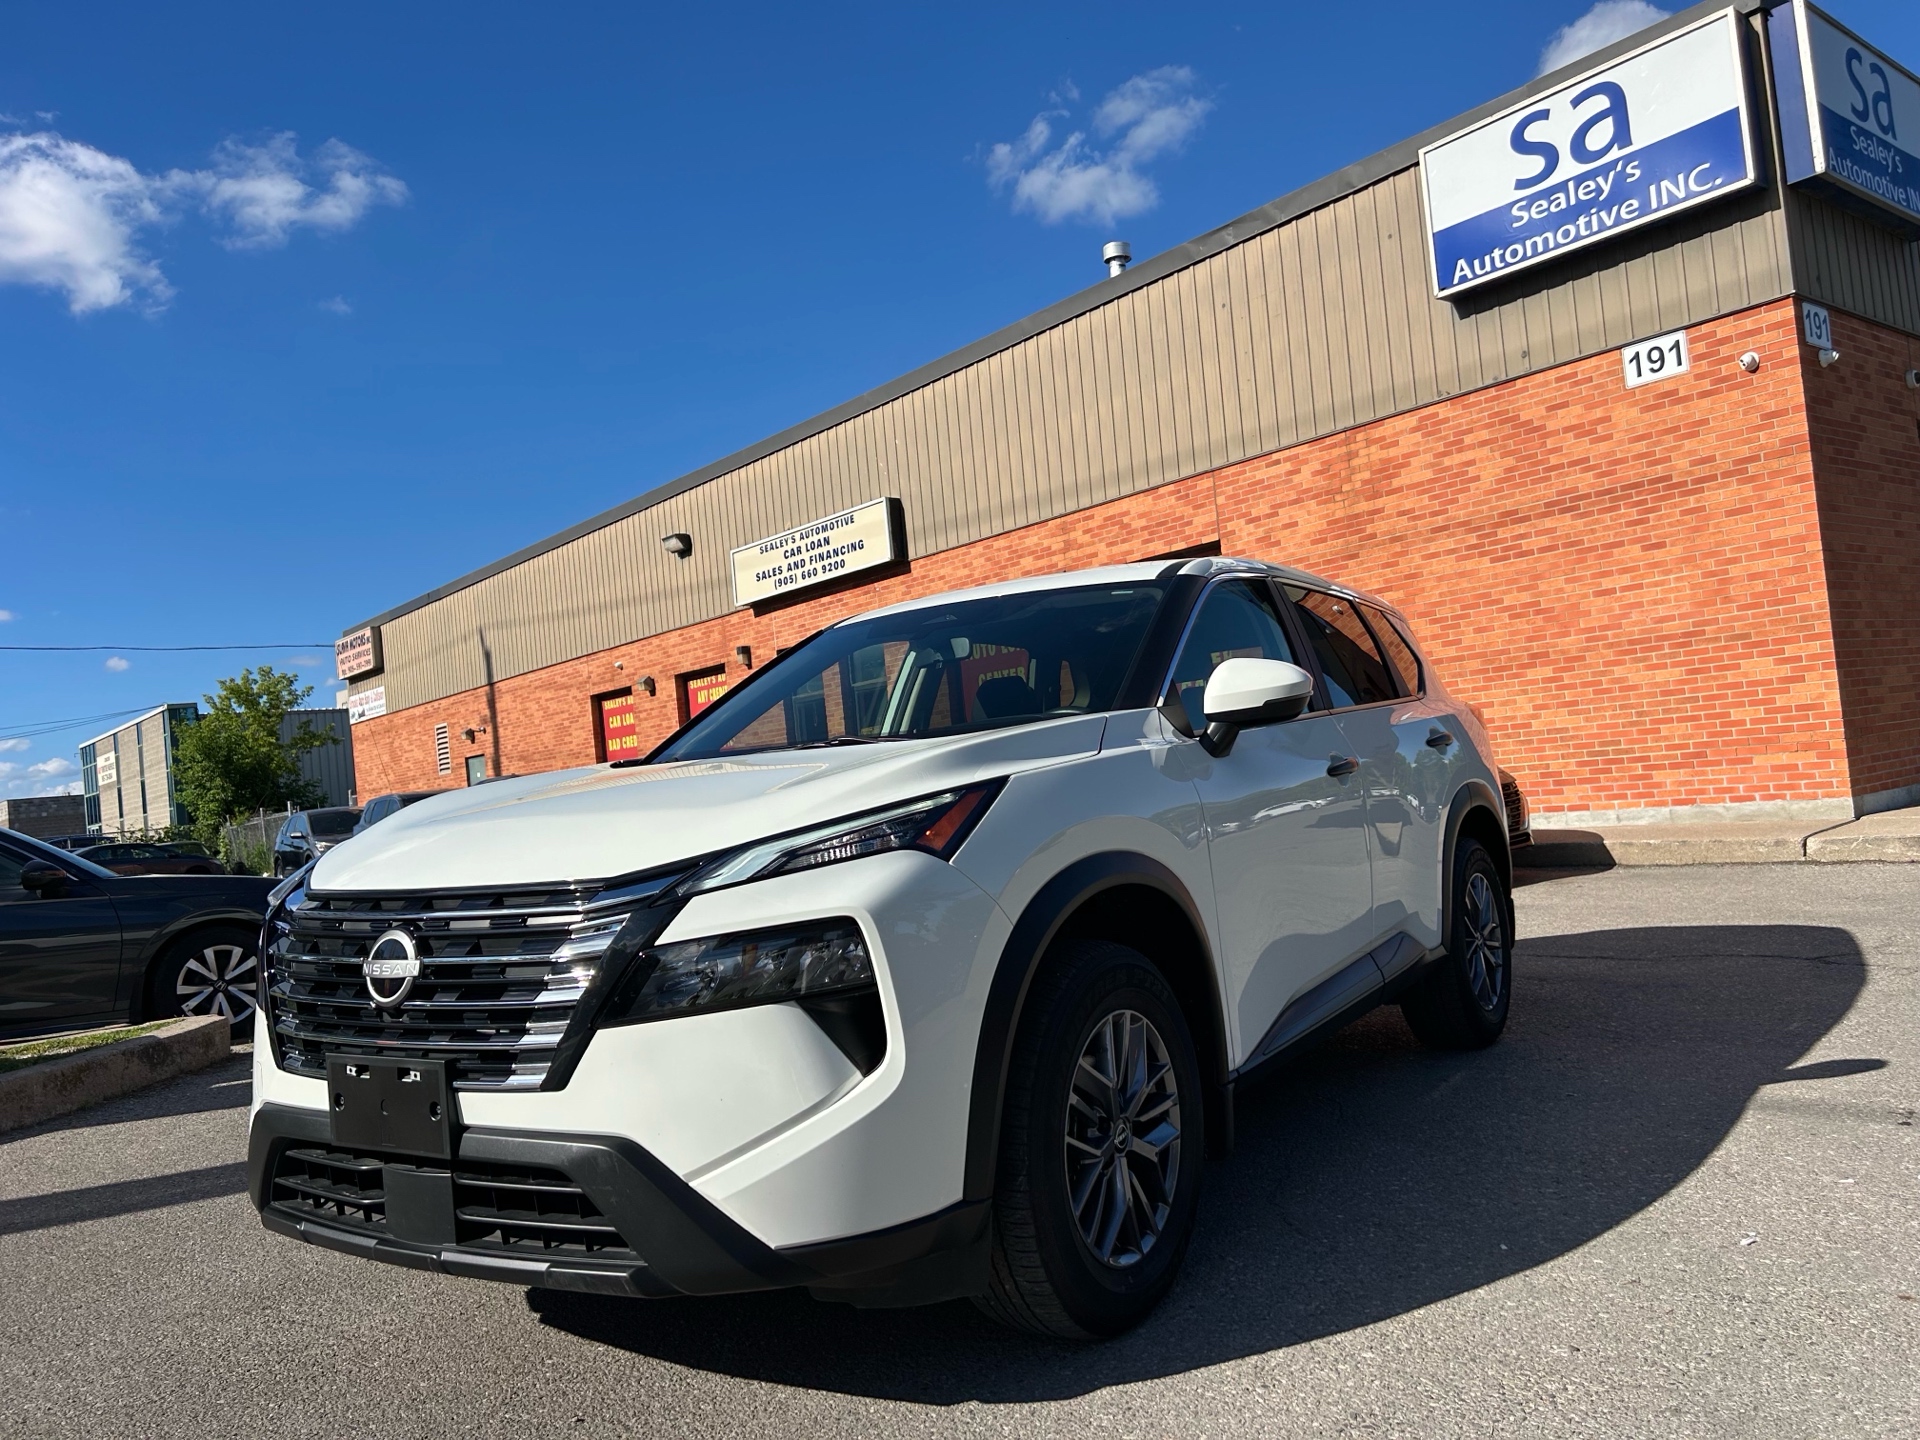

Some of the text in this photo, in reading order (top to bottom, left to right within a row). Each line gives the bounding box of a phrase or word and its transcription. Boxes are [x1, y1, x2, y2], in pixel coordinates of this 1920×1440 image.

[1846, 47, 1897, 141] sa
[1510, 80, 1633, 191] sa
[1850, 125, 1902, 173] Sealey's
[1510, 159, 1641, 228] Sealey's
[1829, 147, 1906, 206] Automotive
[1453, 163, 1723, 285] Automotive INC.
[1804, 309, 1830, 343] 191
[1628, 340, 1684, 378] 191
[759, 514, 855, 555] SEALEY'S AUTOMOTIVE
[783, 536, 831, 560] CAR LOAN
[755, 539, 864, 582] SALES AND FINANCING
[774, 559, 846, 590] (905) 660 9200
[965, 643, 996, 661] UTO
[690, 675, 716, 689] SEALEY'S
[697, 690, 708, 704] ANY
[609, 715, 621, 729] CAR
[608, 739, 620, 751] BAD
[363, 963, 418, 976] NISSAN
